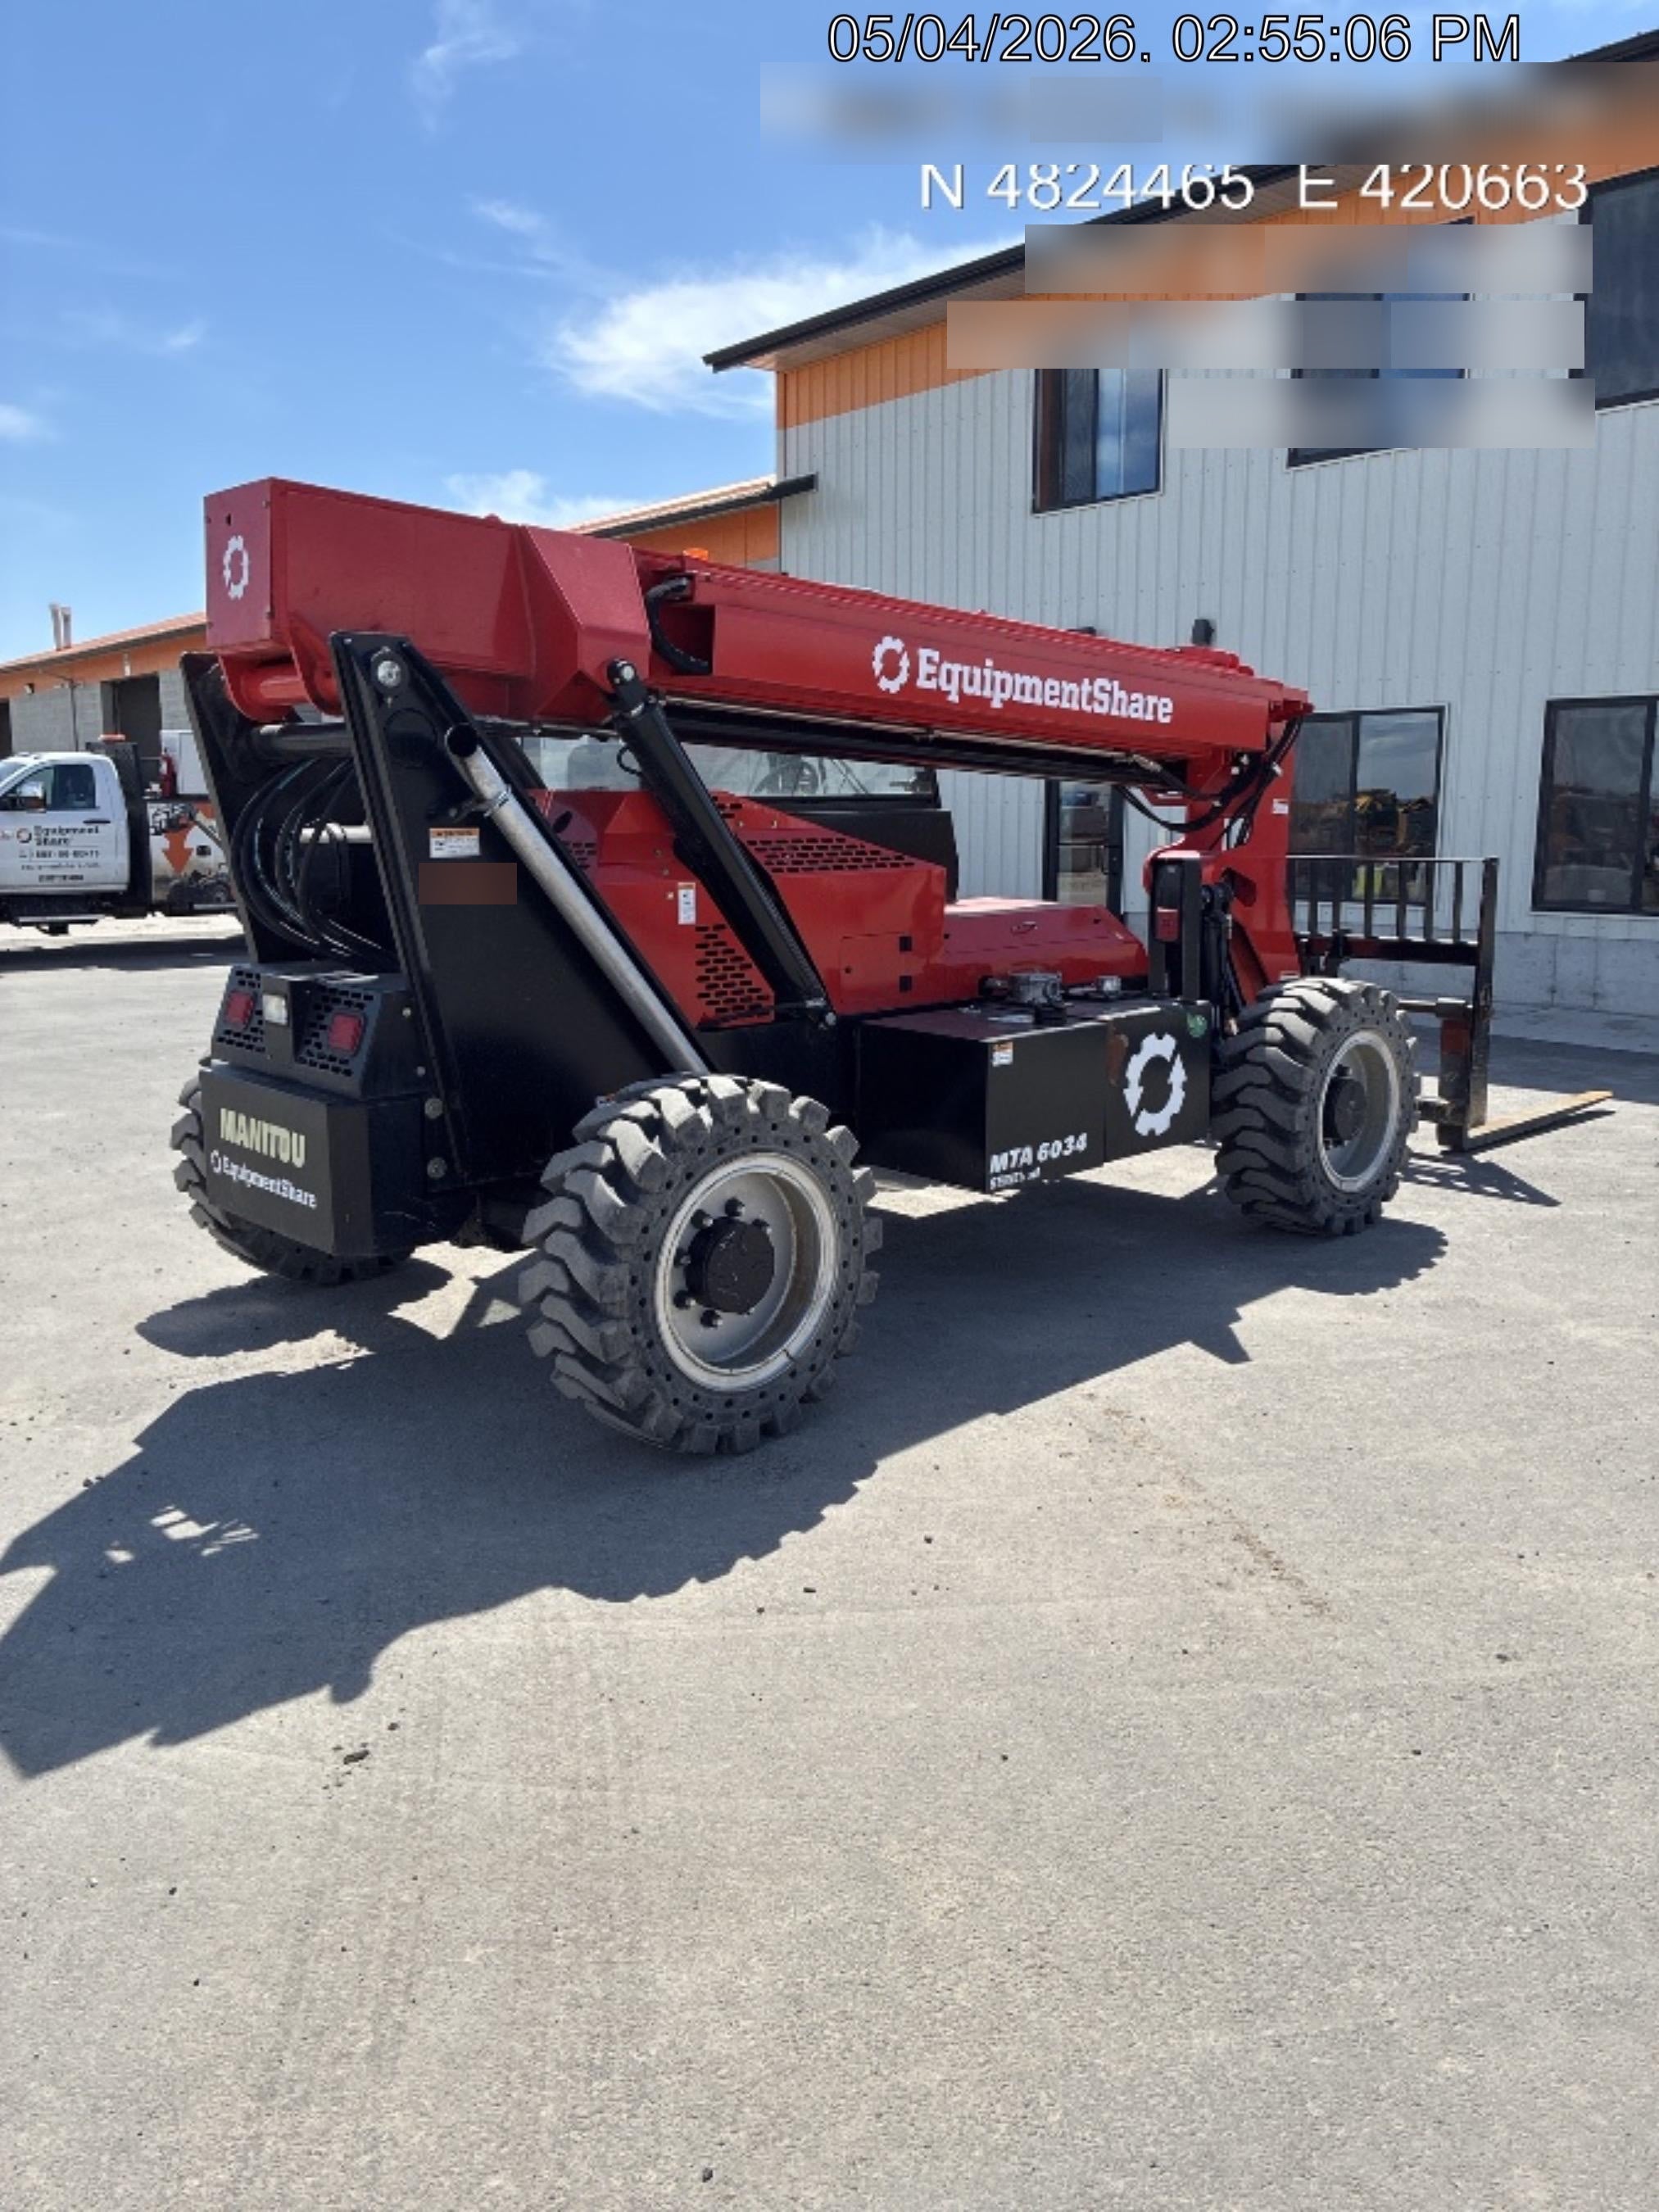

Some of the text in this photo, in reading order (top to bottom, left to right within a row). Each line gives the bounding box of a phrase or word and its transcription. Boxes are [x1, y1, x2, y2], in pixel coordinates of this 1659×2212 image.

[916, 648, 1173, 723] EquipmentShare
[220, 1107, 306, 1168] MANITOU
[990, 1132, 1087, 1174] MTA 6034
[222, 1154, 317, 1209] EquipmentShare
